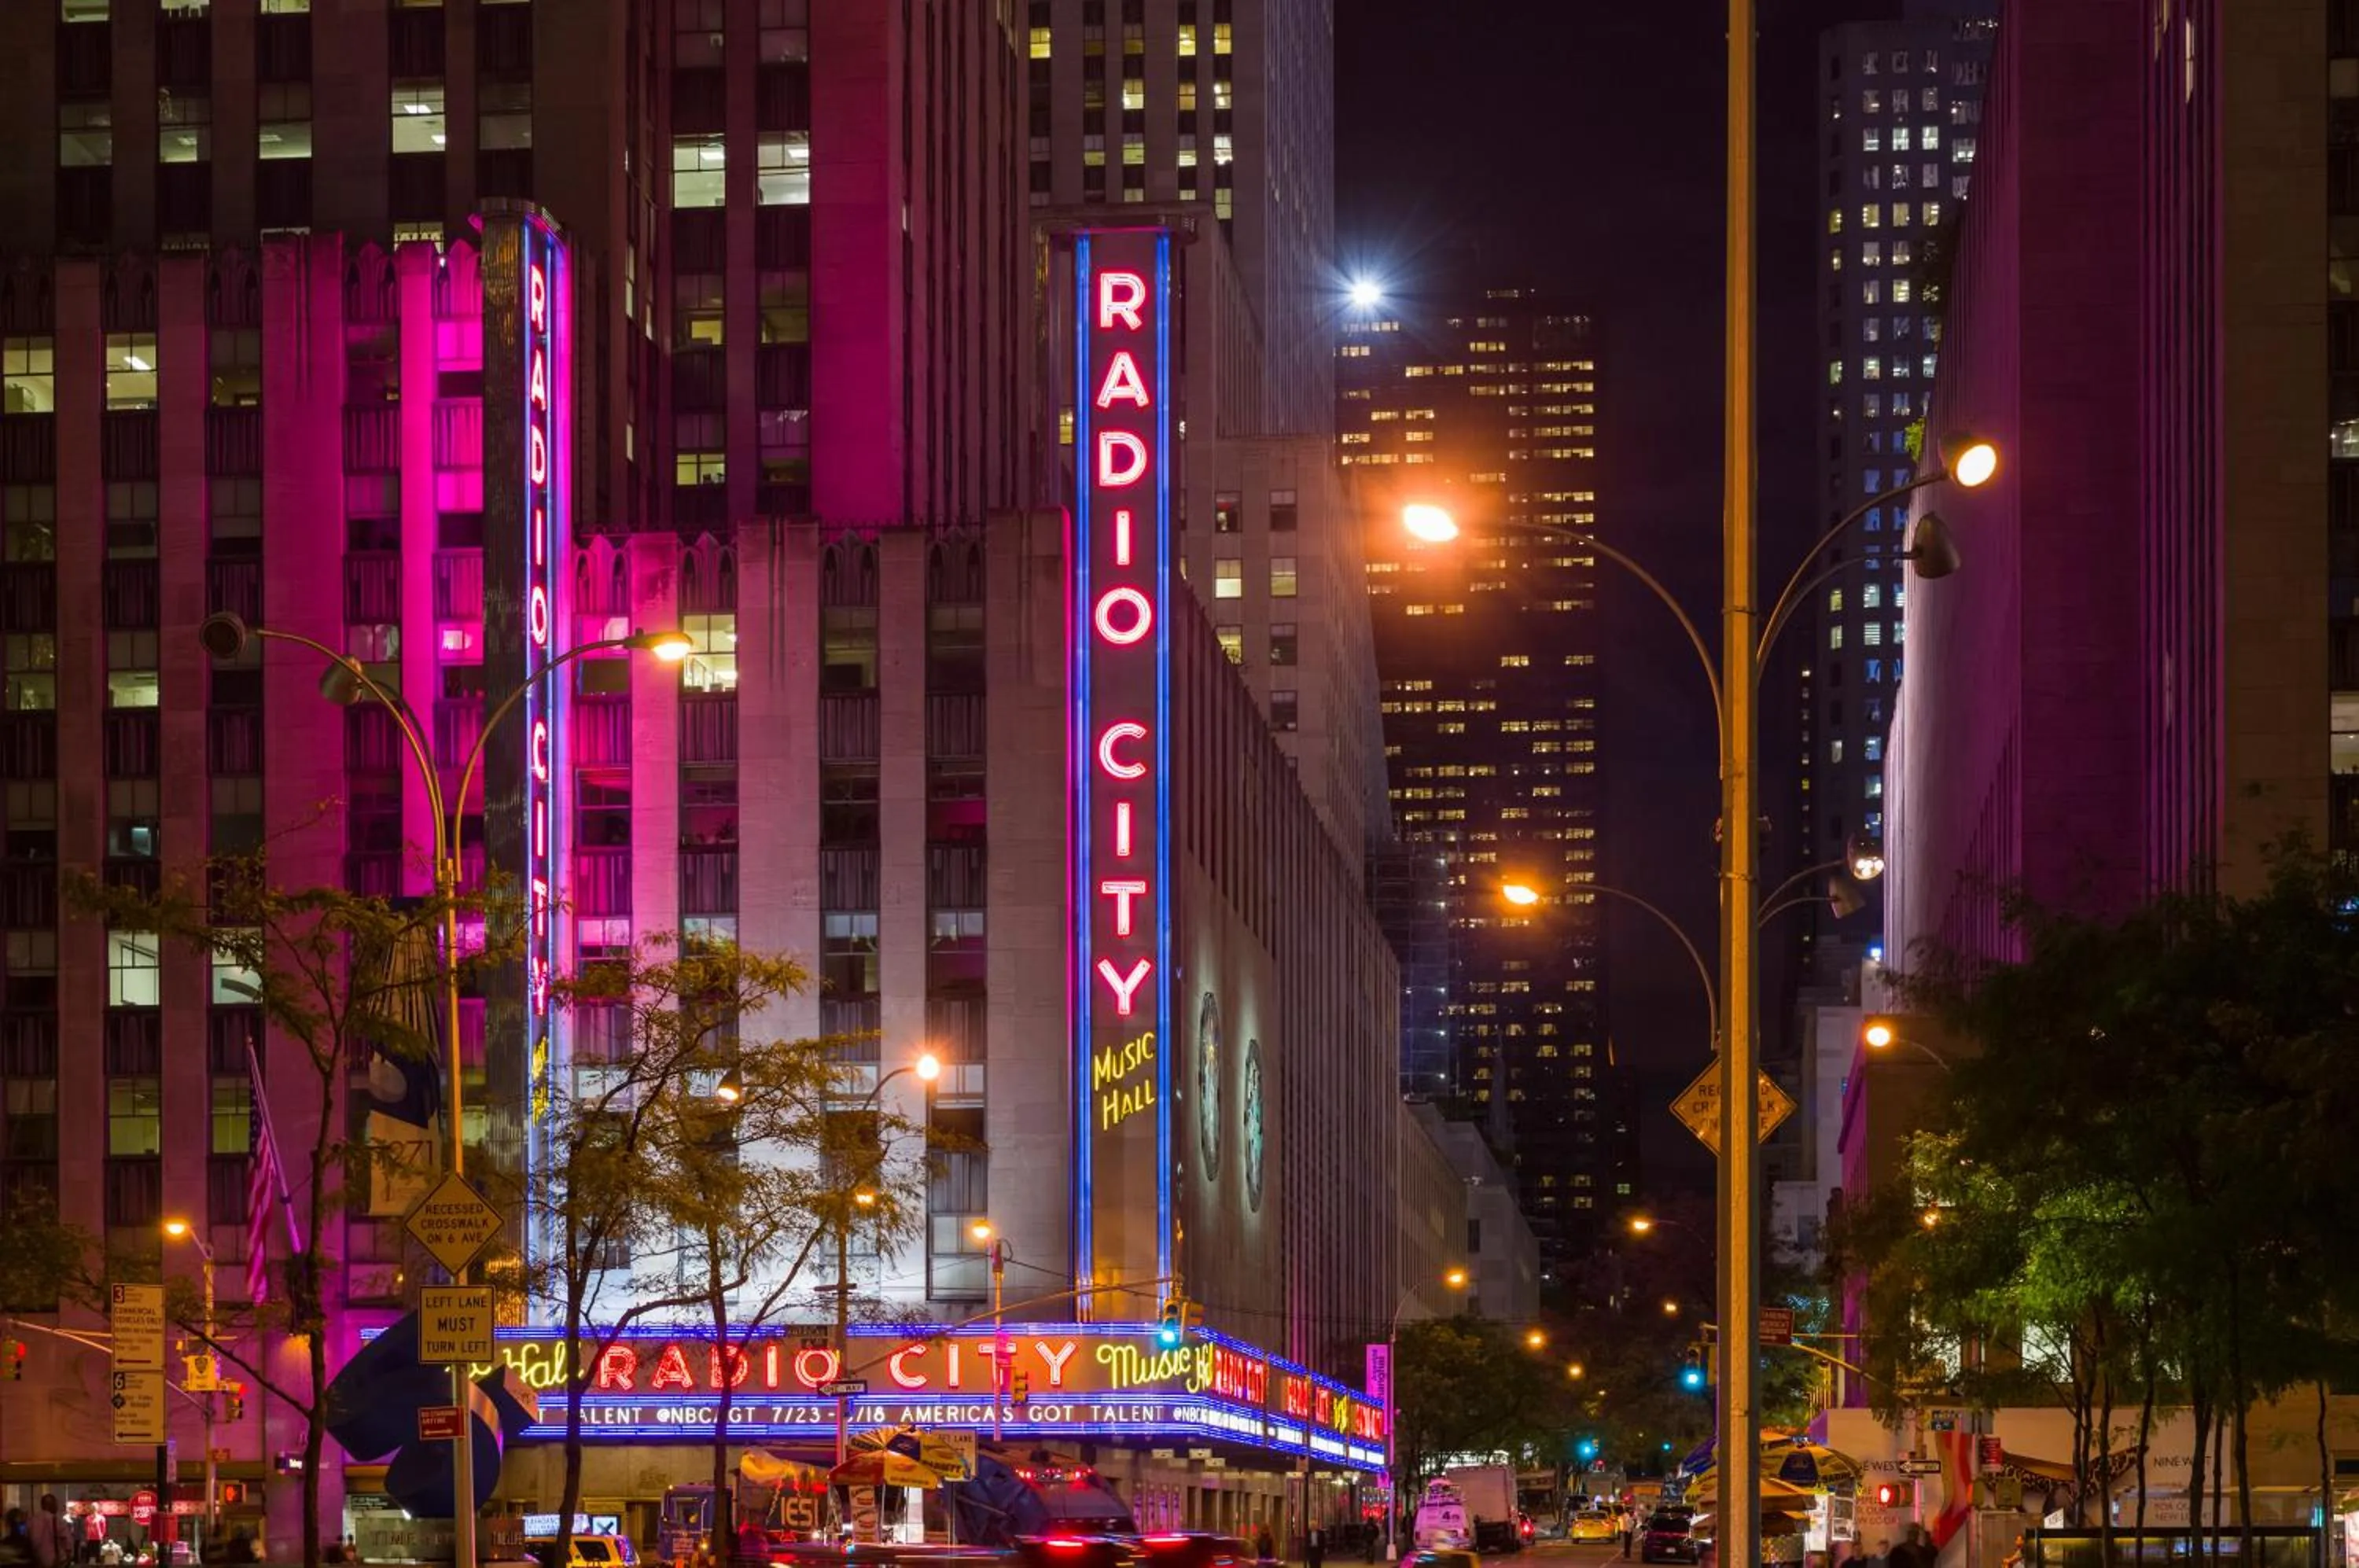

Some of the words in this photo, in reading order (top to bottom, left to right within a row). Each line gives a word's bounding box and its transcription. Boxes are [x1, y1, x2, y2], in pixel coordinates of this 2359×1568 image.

[530, 264, 547, 645] RADIO
[1095, 271, 1152, 644] RADIO
[532, 720, 547, 1016] CITY
[1098, 722, 1151, 1015] CITY
[425, 1204, 484, 1214] RECESSED
[421, 1218, 488, 1228] CROSSWALK
[427, 1234, 442, 1244] ON
[461, 1231, 483, 1242] AVE
[115, 1286, 123, 1302] 3
[425, 1296, 452, 1309] LEFT
[458, 1296, 487, 1309] LANE
[437, 1316, 476, 1331] MUST
[427, 1341, 455, 1353] TURN
[462, 1341, 487, 1353] LEFT
[502, 1341, 584, 1388] Hal
[600, 1344, 838, 1389] RADIO
[889, 1341, 1076, 1388] CITY
[1096, 1344, 1191, 1389] Music
[114, 1373, 123, 1389] 6
[563, 1408, 642, 1424] ALENT
[657, 1408, 755, 1424] @NBCGT
[1029, 1405, 1073, 1423] GOT
[1091, 1405, 1164, 1423] TALENT
